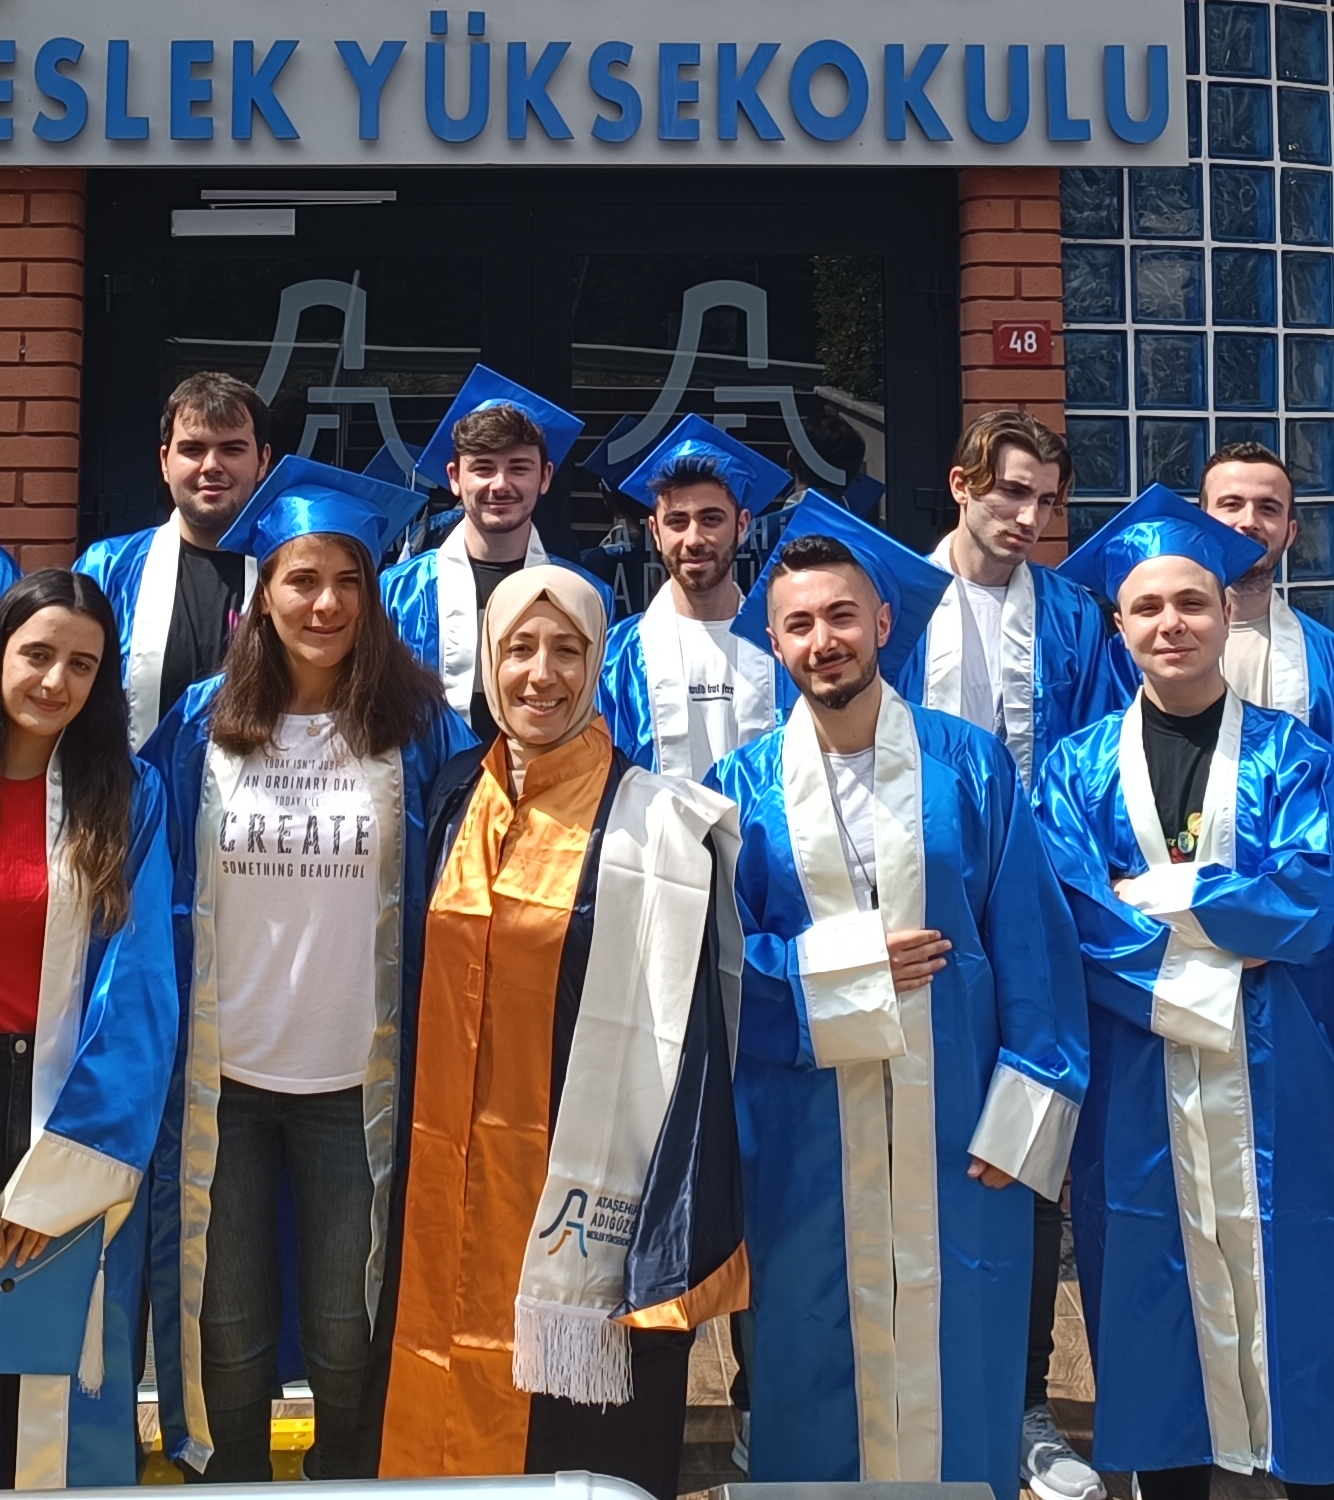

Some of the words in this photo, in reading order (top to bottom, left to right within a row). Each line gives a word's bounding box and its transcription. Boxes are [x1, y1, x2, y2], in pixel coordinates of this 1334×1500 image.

[335, 10, 1170, 145] YÜKSEKOKULU
[1009, 330, 1038, 354] 48
[265, 758, 290, 770] TODAY
[293, 759, 316, 770] ISN'T
[243, 775, 260, 790] AN
[265, 775, 328, 791] ORDINARY
[333, 778, 356, 792] DAY
[275, 796, 301, 807] TODAY
[219, 811, 370, 856] CREATE
[222, 860, 295, 878] SOMETHING
[300, 863, 366, 879] BEAUTIFUL
[590, 1212, 636, 1235] ADIGÜZE
